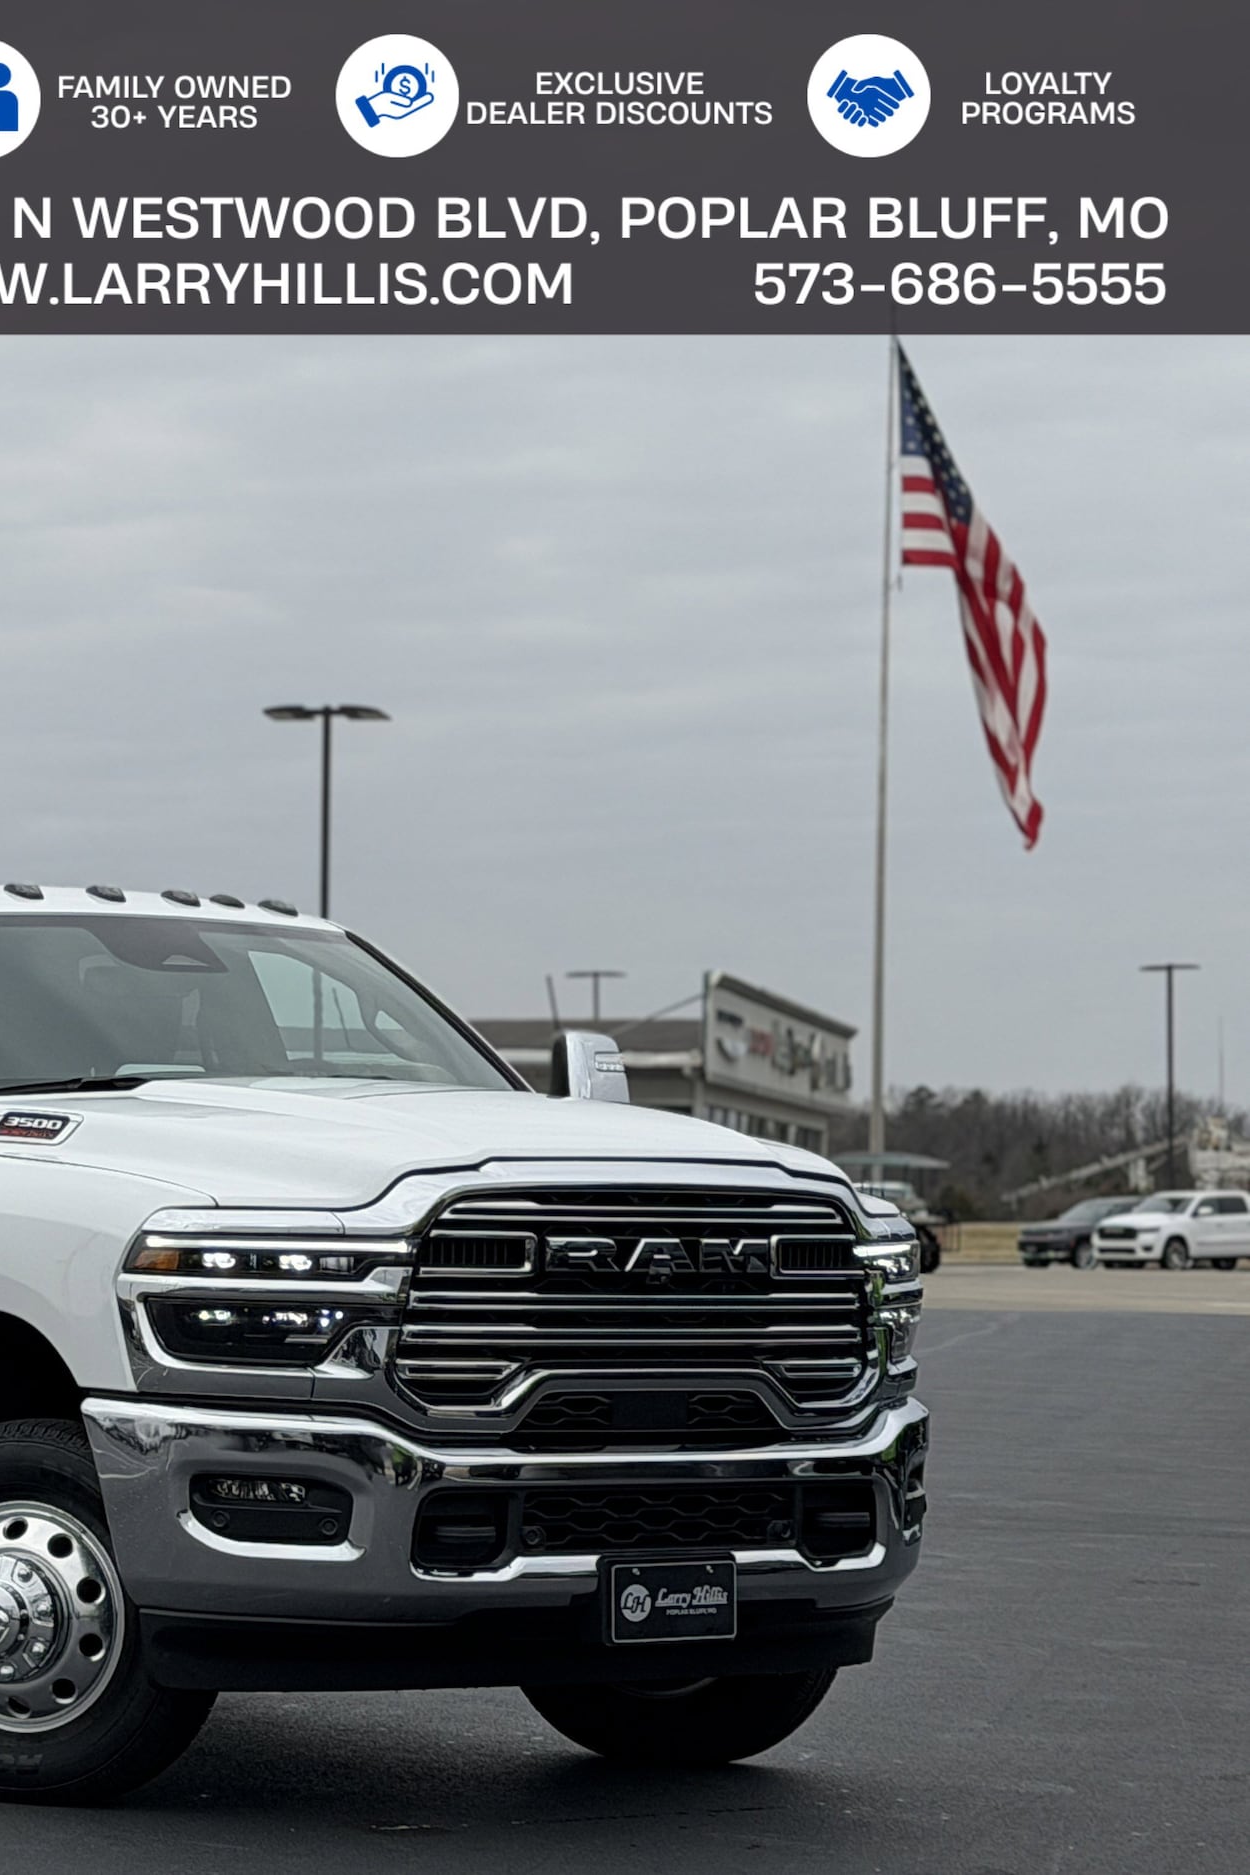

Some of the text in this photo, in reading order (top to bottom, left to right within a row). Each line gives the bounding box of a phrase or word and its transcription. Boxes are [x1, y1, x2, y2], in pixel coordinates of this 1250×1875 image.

[3, 1116, 63, 1130] 3500
[544, 1235, 770, 1273] RAM
[655, 1585, 729, 1608] Larry Hillis
